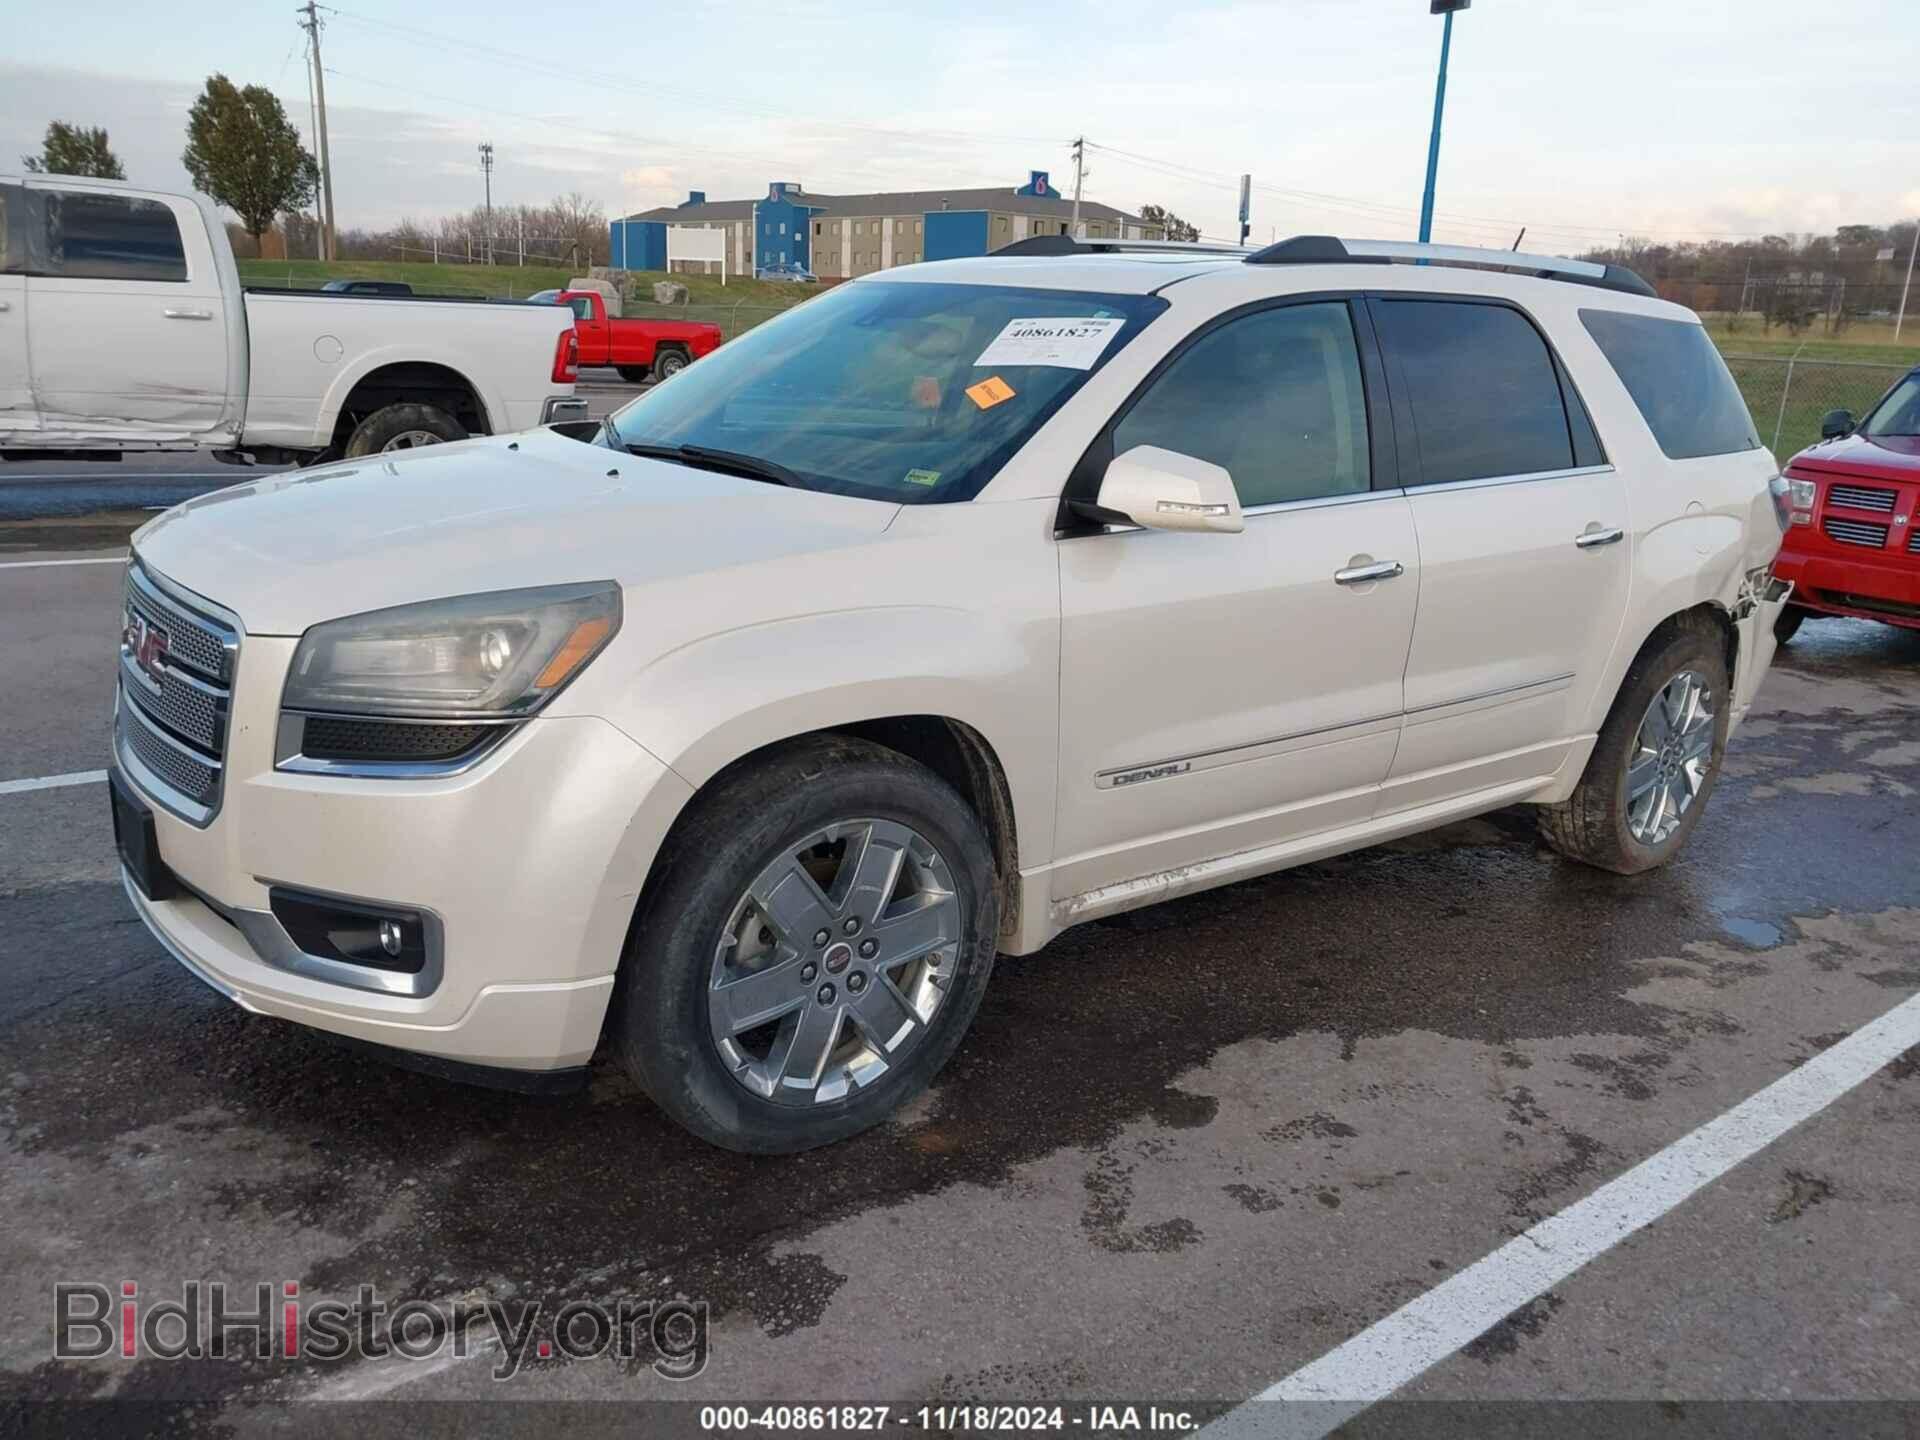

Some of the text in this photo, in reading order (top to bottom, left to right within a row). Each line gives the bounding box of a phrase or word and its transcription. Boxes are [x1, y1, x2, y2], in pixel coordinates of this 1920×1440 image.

[1035, 175, 1047, 195] 6
[1009, 327, 1103, 338] 40861827
[1112, 761, 1191, 786] DENALI
